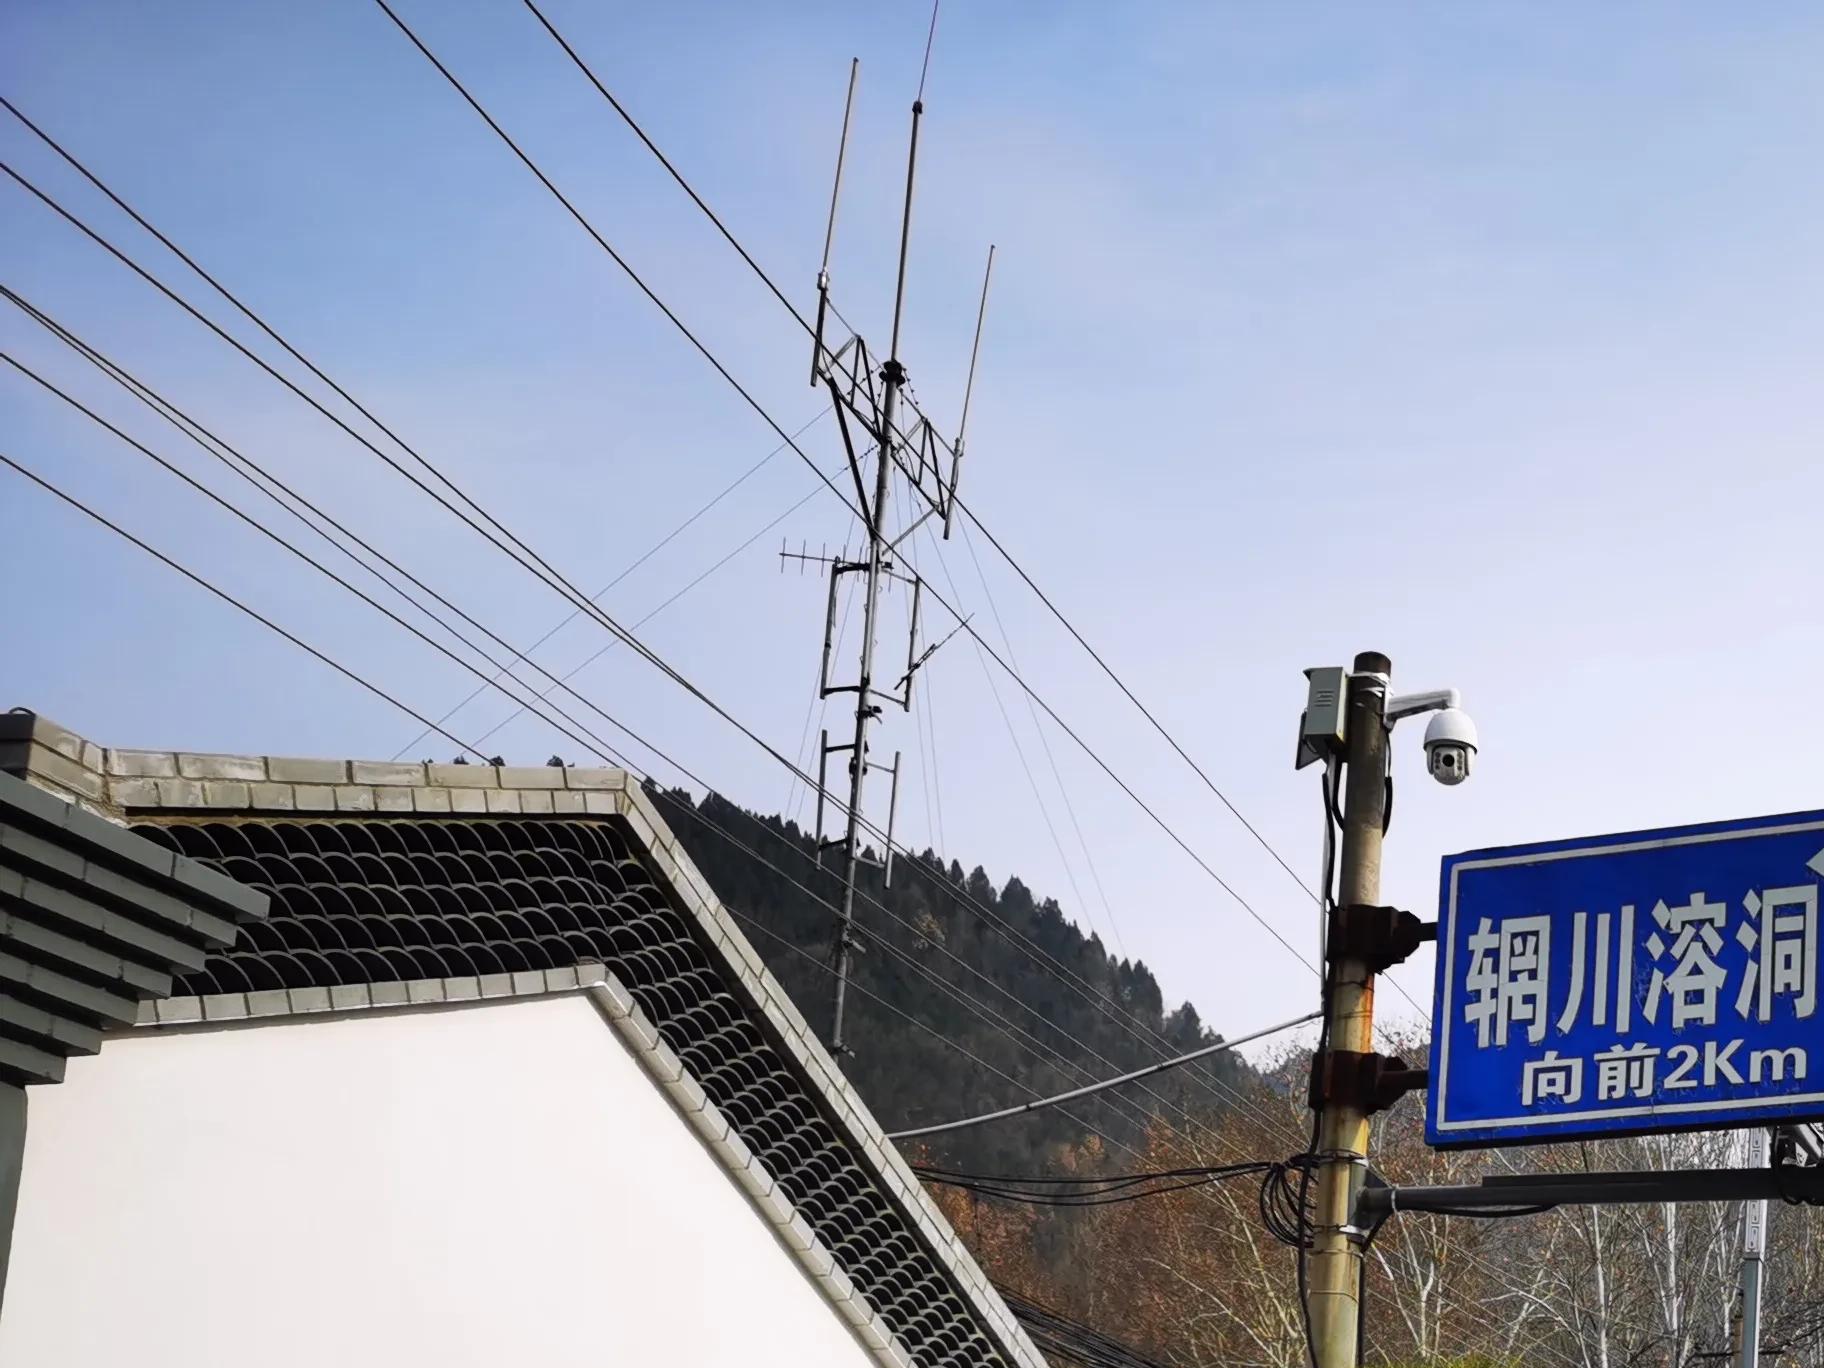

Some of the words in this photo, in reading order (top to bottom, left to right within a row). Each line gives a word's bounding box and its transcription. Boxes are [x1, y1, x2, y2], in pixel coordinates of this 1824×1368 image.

[1465, 884, 1818, 1048] 辋川溶洞
[1521, 1039, 1807, 1105] 向前2Km
